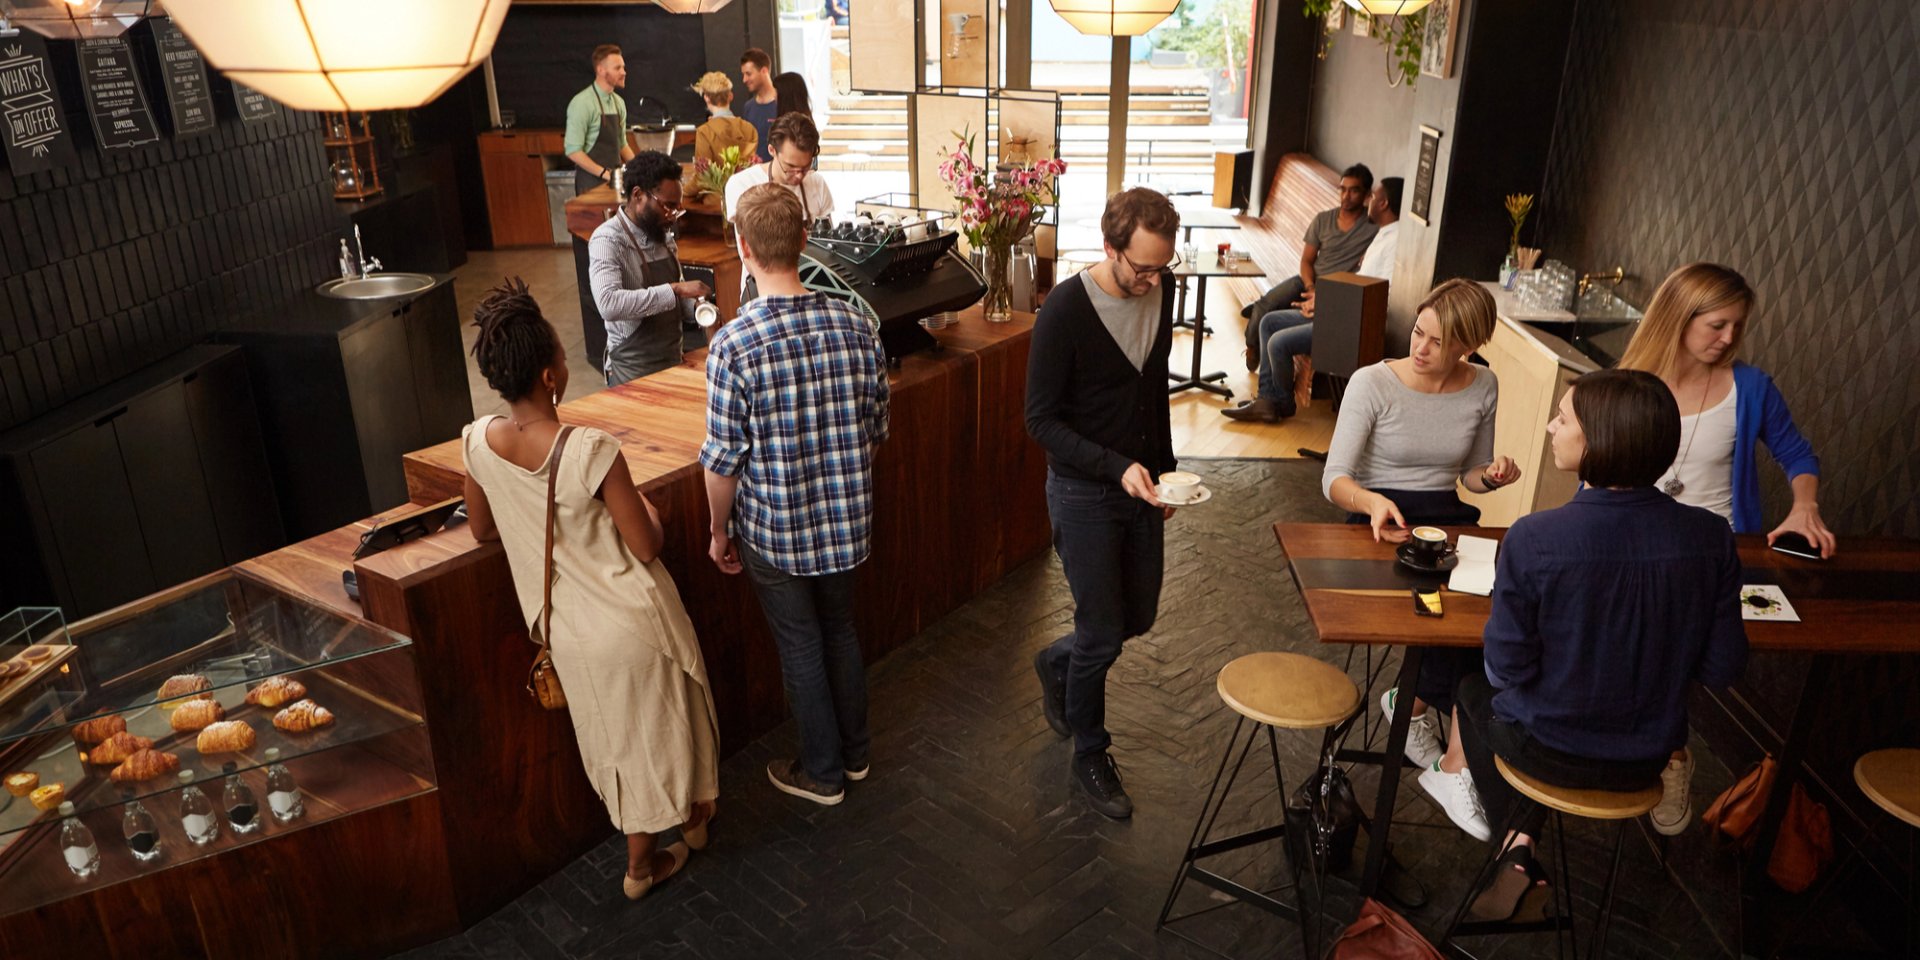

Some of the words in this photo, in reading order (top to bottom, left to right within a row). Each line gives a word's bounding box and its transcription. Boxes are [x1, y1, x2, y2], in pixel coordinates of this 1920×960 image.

[0, 64, 42, 96] WHAT'S
[13, 118, 25, 135] ON
[23, 106, 60, 136] OFFER
